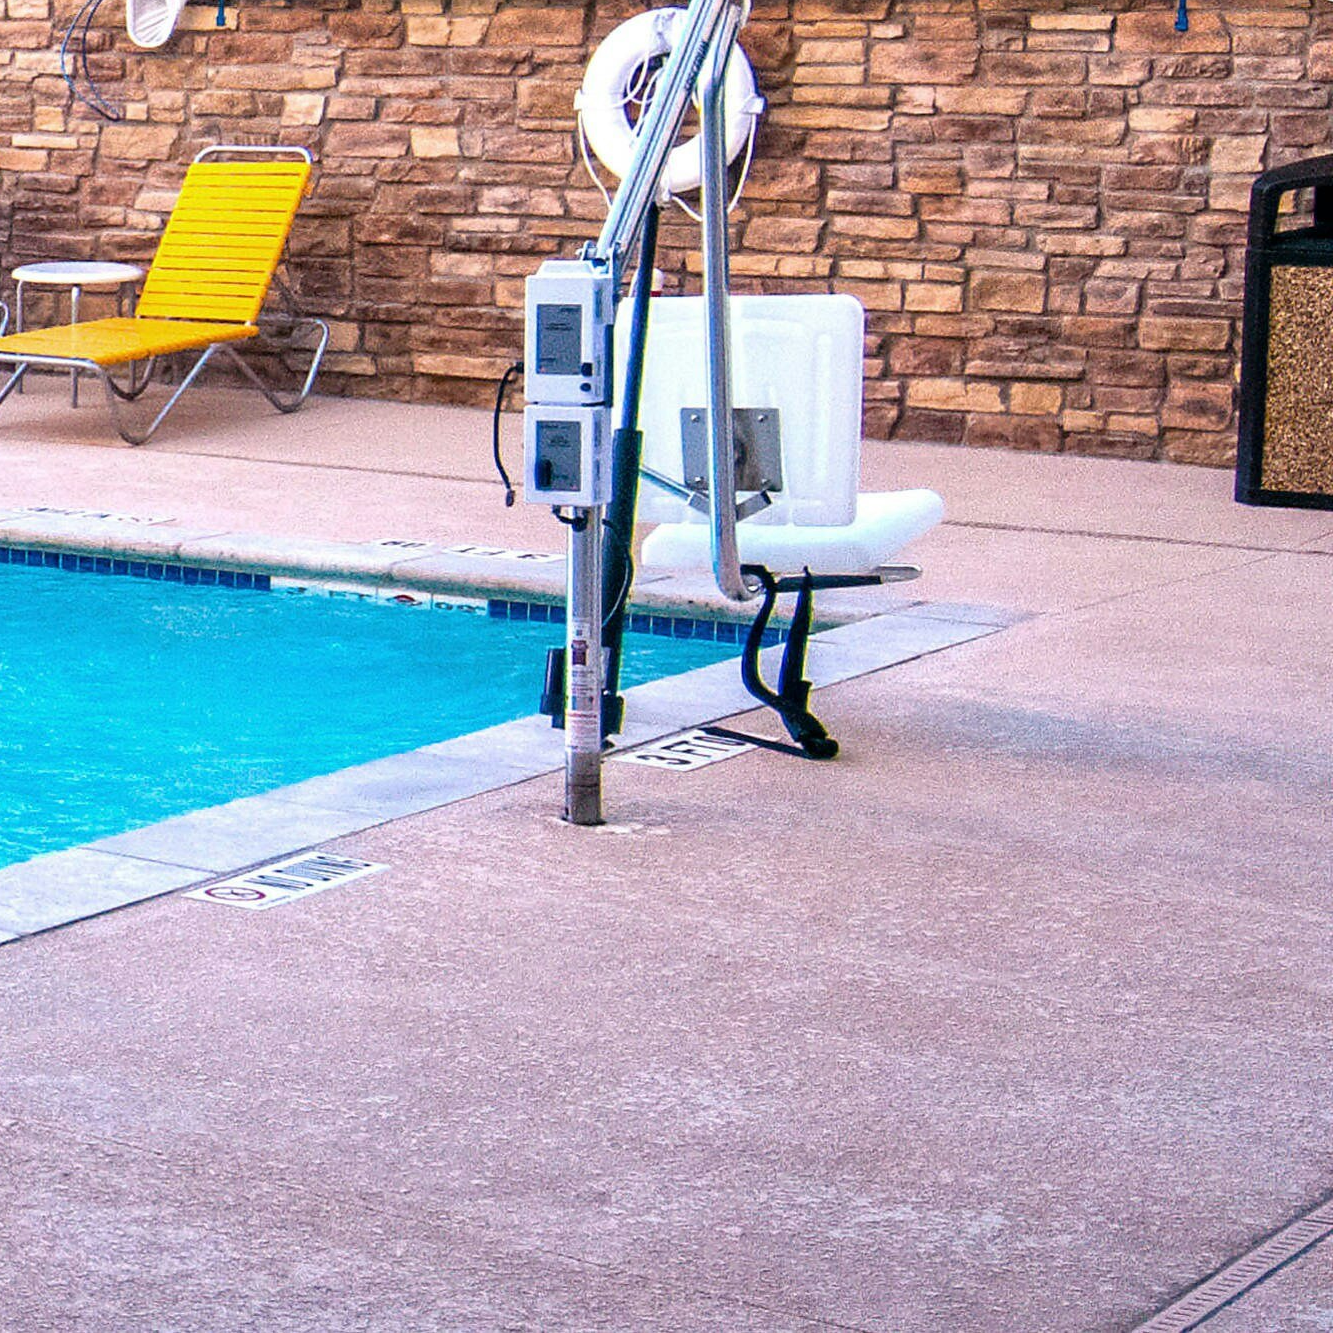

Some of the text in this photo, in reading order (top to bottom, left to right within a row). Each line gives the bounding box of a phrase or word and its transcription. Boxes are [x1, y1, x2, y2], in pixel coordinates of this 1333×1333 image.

[660, 740, 730, 758] FT
[636, 754, 692, 765] 3
[243, 874, 314, 892] NO
